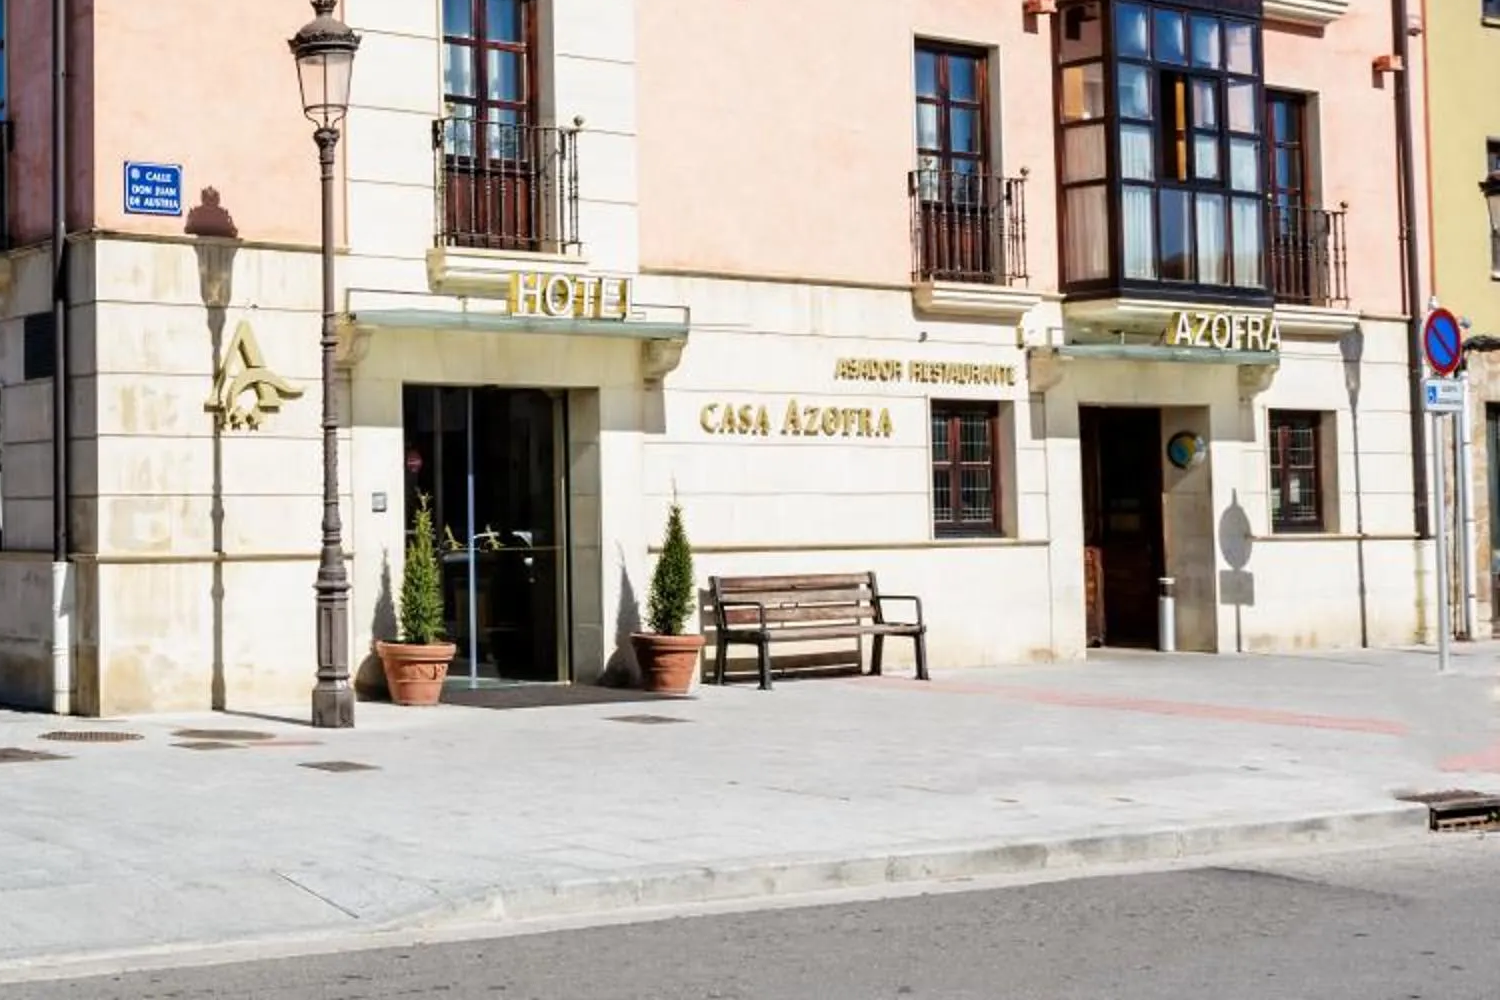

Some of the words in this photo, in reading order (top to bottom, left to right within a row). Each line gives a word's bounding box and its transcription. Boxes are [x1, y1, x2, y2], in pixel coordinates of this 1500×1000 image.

[131, 184, 153, 195] DON
[156, 186, 177, 197] JUAN
[145, 171, 172, 183] CALLE
[144, 198, 179, 209] AUSTRIA
[510, 272, 646, 322] HOTEL
[1168, 311, 1283, 351] AZOFRA
[834, 358, 902, 382] ASADOR
[908, 360, 1016, 387] RESTAURANTE
[699, 402, 771, 437] CASA
[780, 397, 893, 438] AZOFRA
